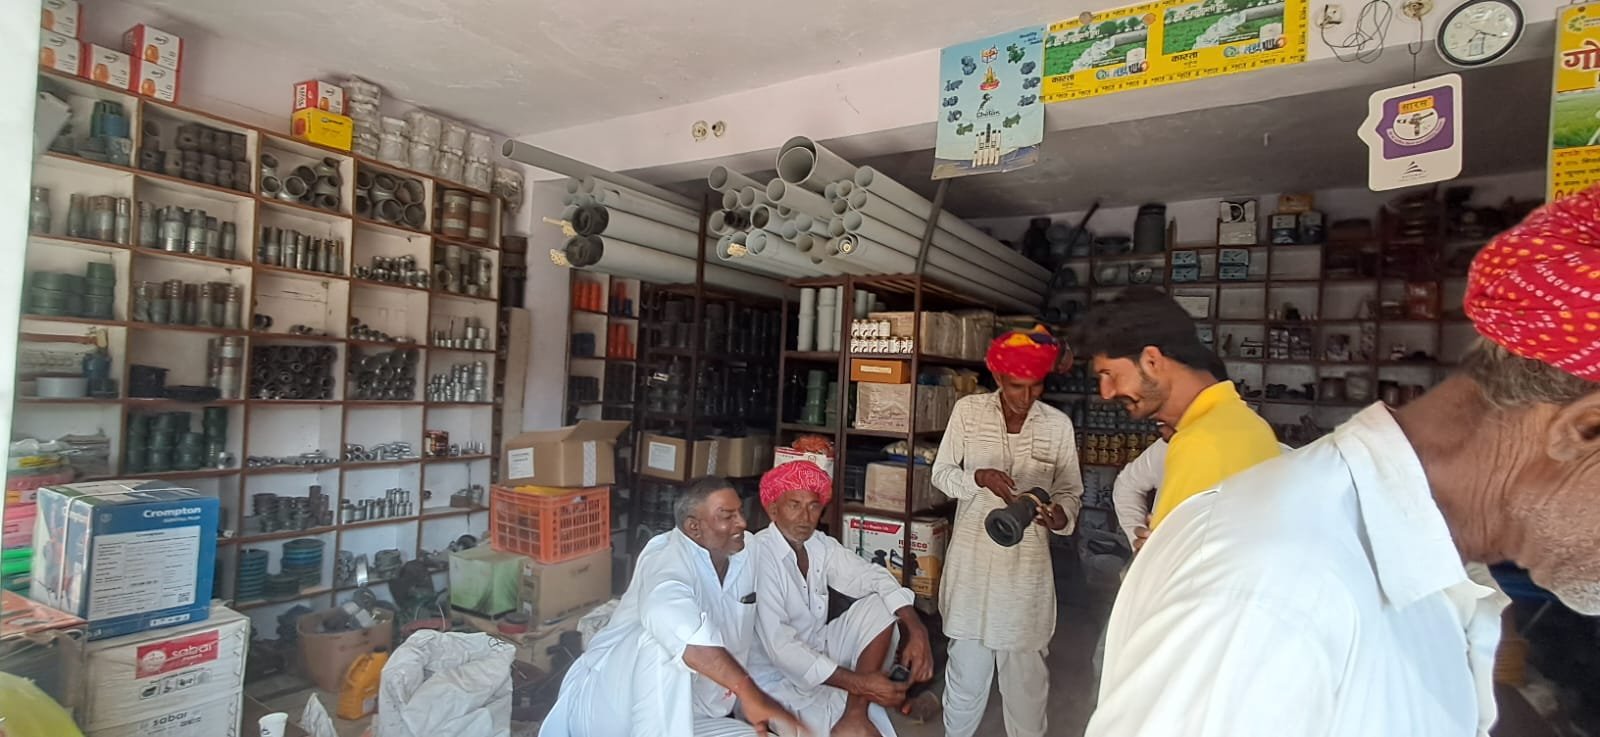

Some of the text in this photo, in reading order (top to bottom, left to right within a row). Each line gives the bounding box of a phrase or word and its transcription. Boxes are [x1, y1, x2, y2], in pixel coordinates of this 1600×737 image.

[1402, 99, 1428, 110] सारस
[143, 507, 201, 518] Crompton
[172, 643, 212, 657] sabar
[153, 711, 188, 726] sabar
